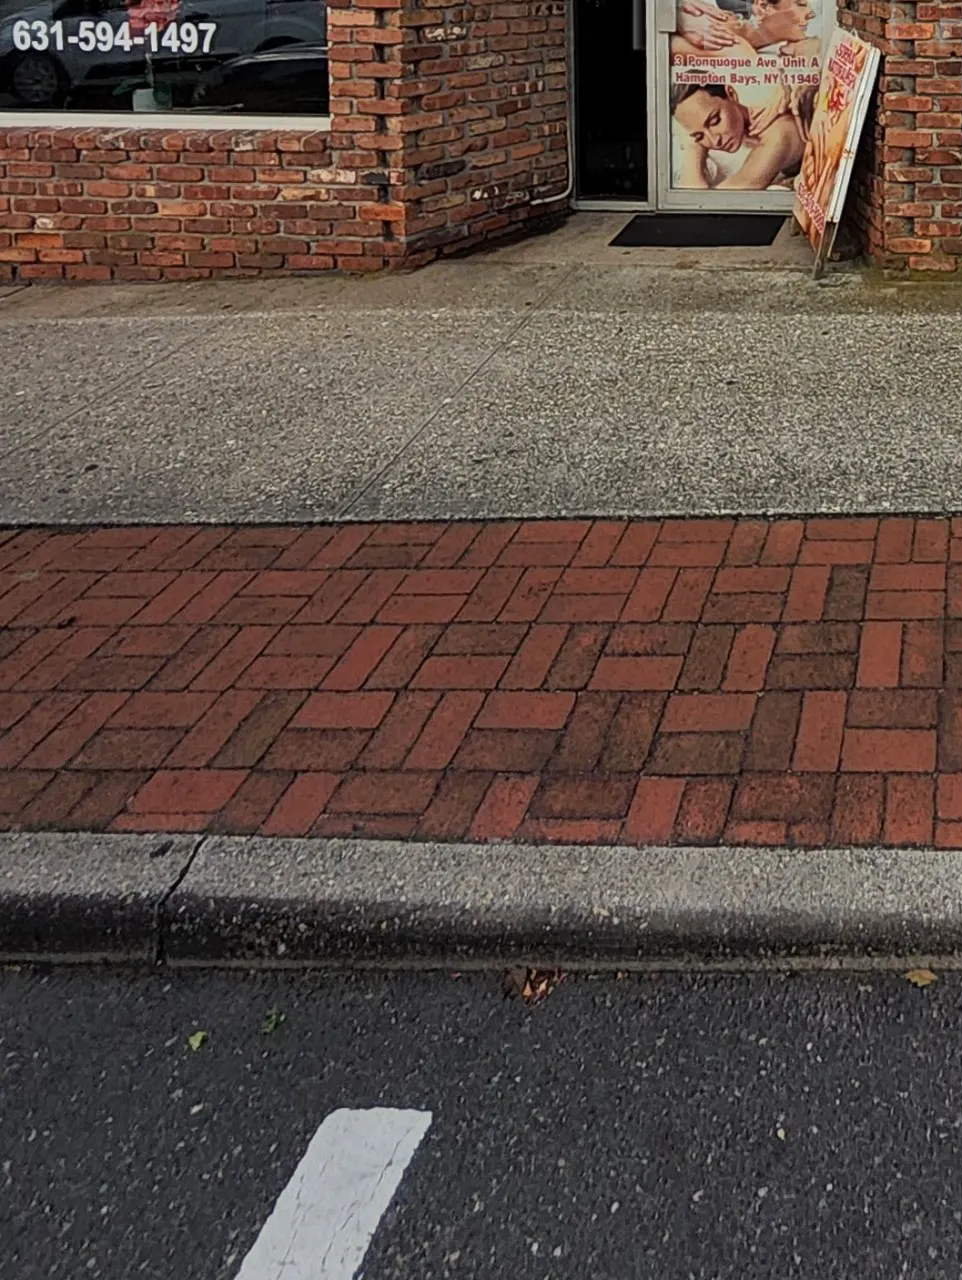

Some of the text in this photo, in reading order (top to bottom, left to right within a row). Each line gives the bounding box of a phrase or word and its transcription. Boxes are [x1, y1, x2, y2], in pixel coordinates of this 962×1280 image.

[12, 20, 217, 53] 631-594-1497
[688, 56, 752, 69] Ponquogue
[756, 56, 777, 68] Ave
[783, 56, 806, 68] Unit
[811, 57, 820, 68] A
[675, 73, 820, 86] Hampton Bays, NY 11946
